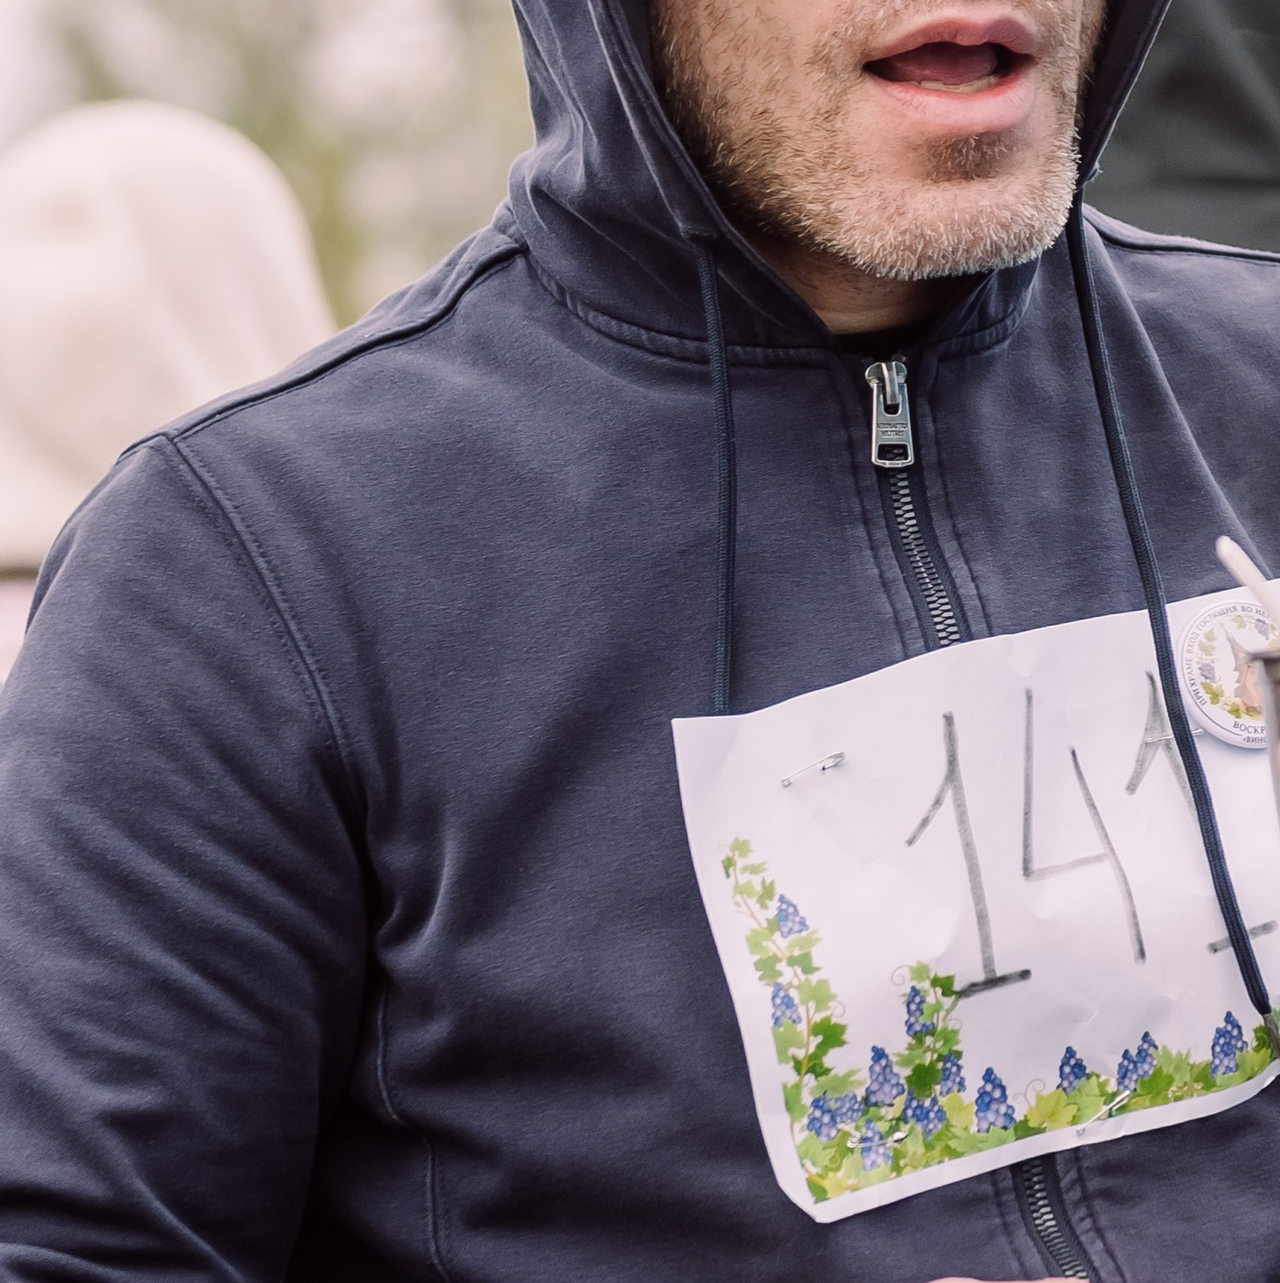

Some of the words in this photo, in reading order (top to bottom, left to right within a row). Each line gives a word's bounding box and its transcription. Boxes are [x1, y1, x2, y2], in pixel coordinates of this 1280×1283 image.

[1195, 605, 1239, 630] ГОСПОДНЯ
[1240, 605, 1253, 613] ВО
[1186, 631, 1200, 654] ВХОД
[1185, 657, 1198, 687] ХРАМЕ
[1192, 688, 1207, 706] ПРИ
[1233, 721, 1266, 734] ВОСКР
[906, 670, 1278, 1000] 141
